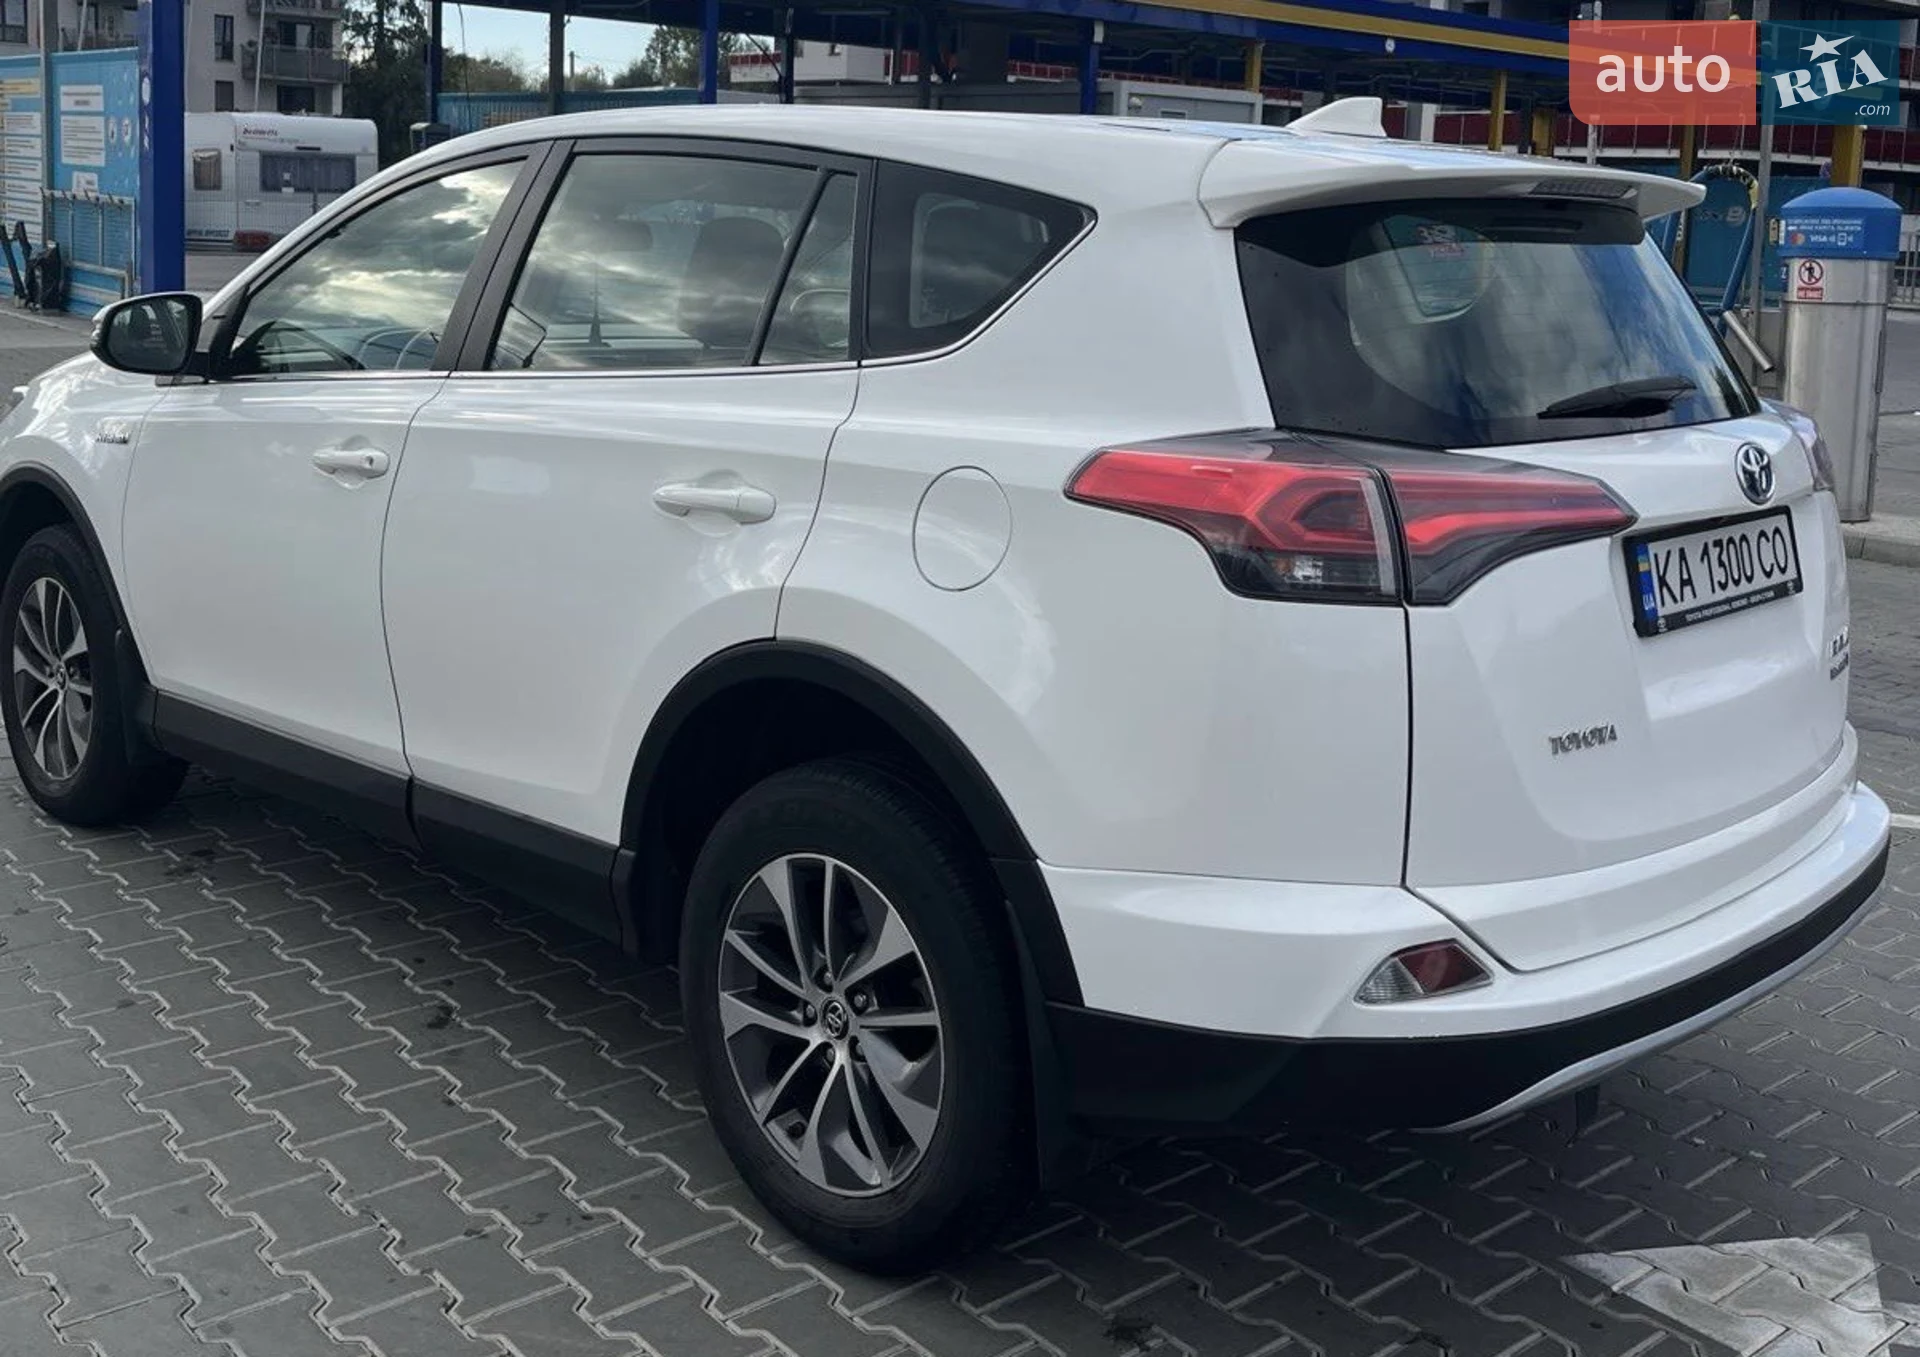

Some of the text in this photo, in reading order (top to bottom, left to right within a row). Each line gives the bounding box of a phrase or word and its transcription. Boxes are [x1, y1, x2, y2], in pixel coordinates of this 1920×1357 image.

[1653, 547, 1697, 608] KA
[1700, 536, 1755, 595] 1300
[1757, 526, 1788, 578] CO
[1642, 594, 1655, 610] UA
[1549, 724, 1618, 755] TOYOTA
